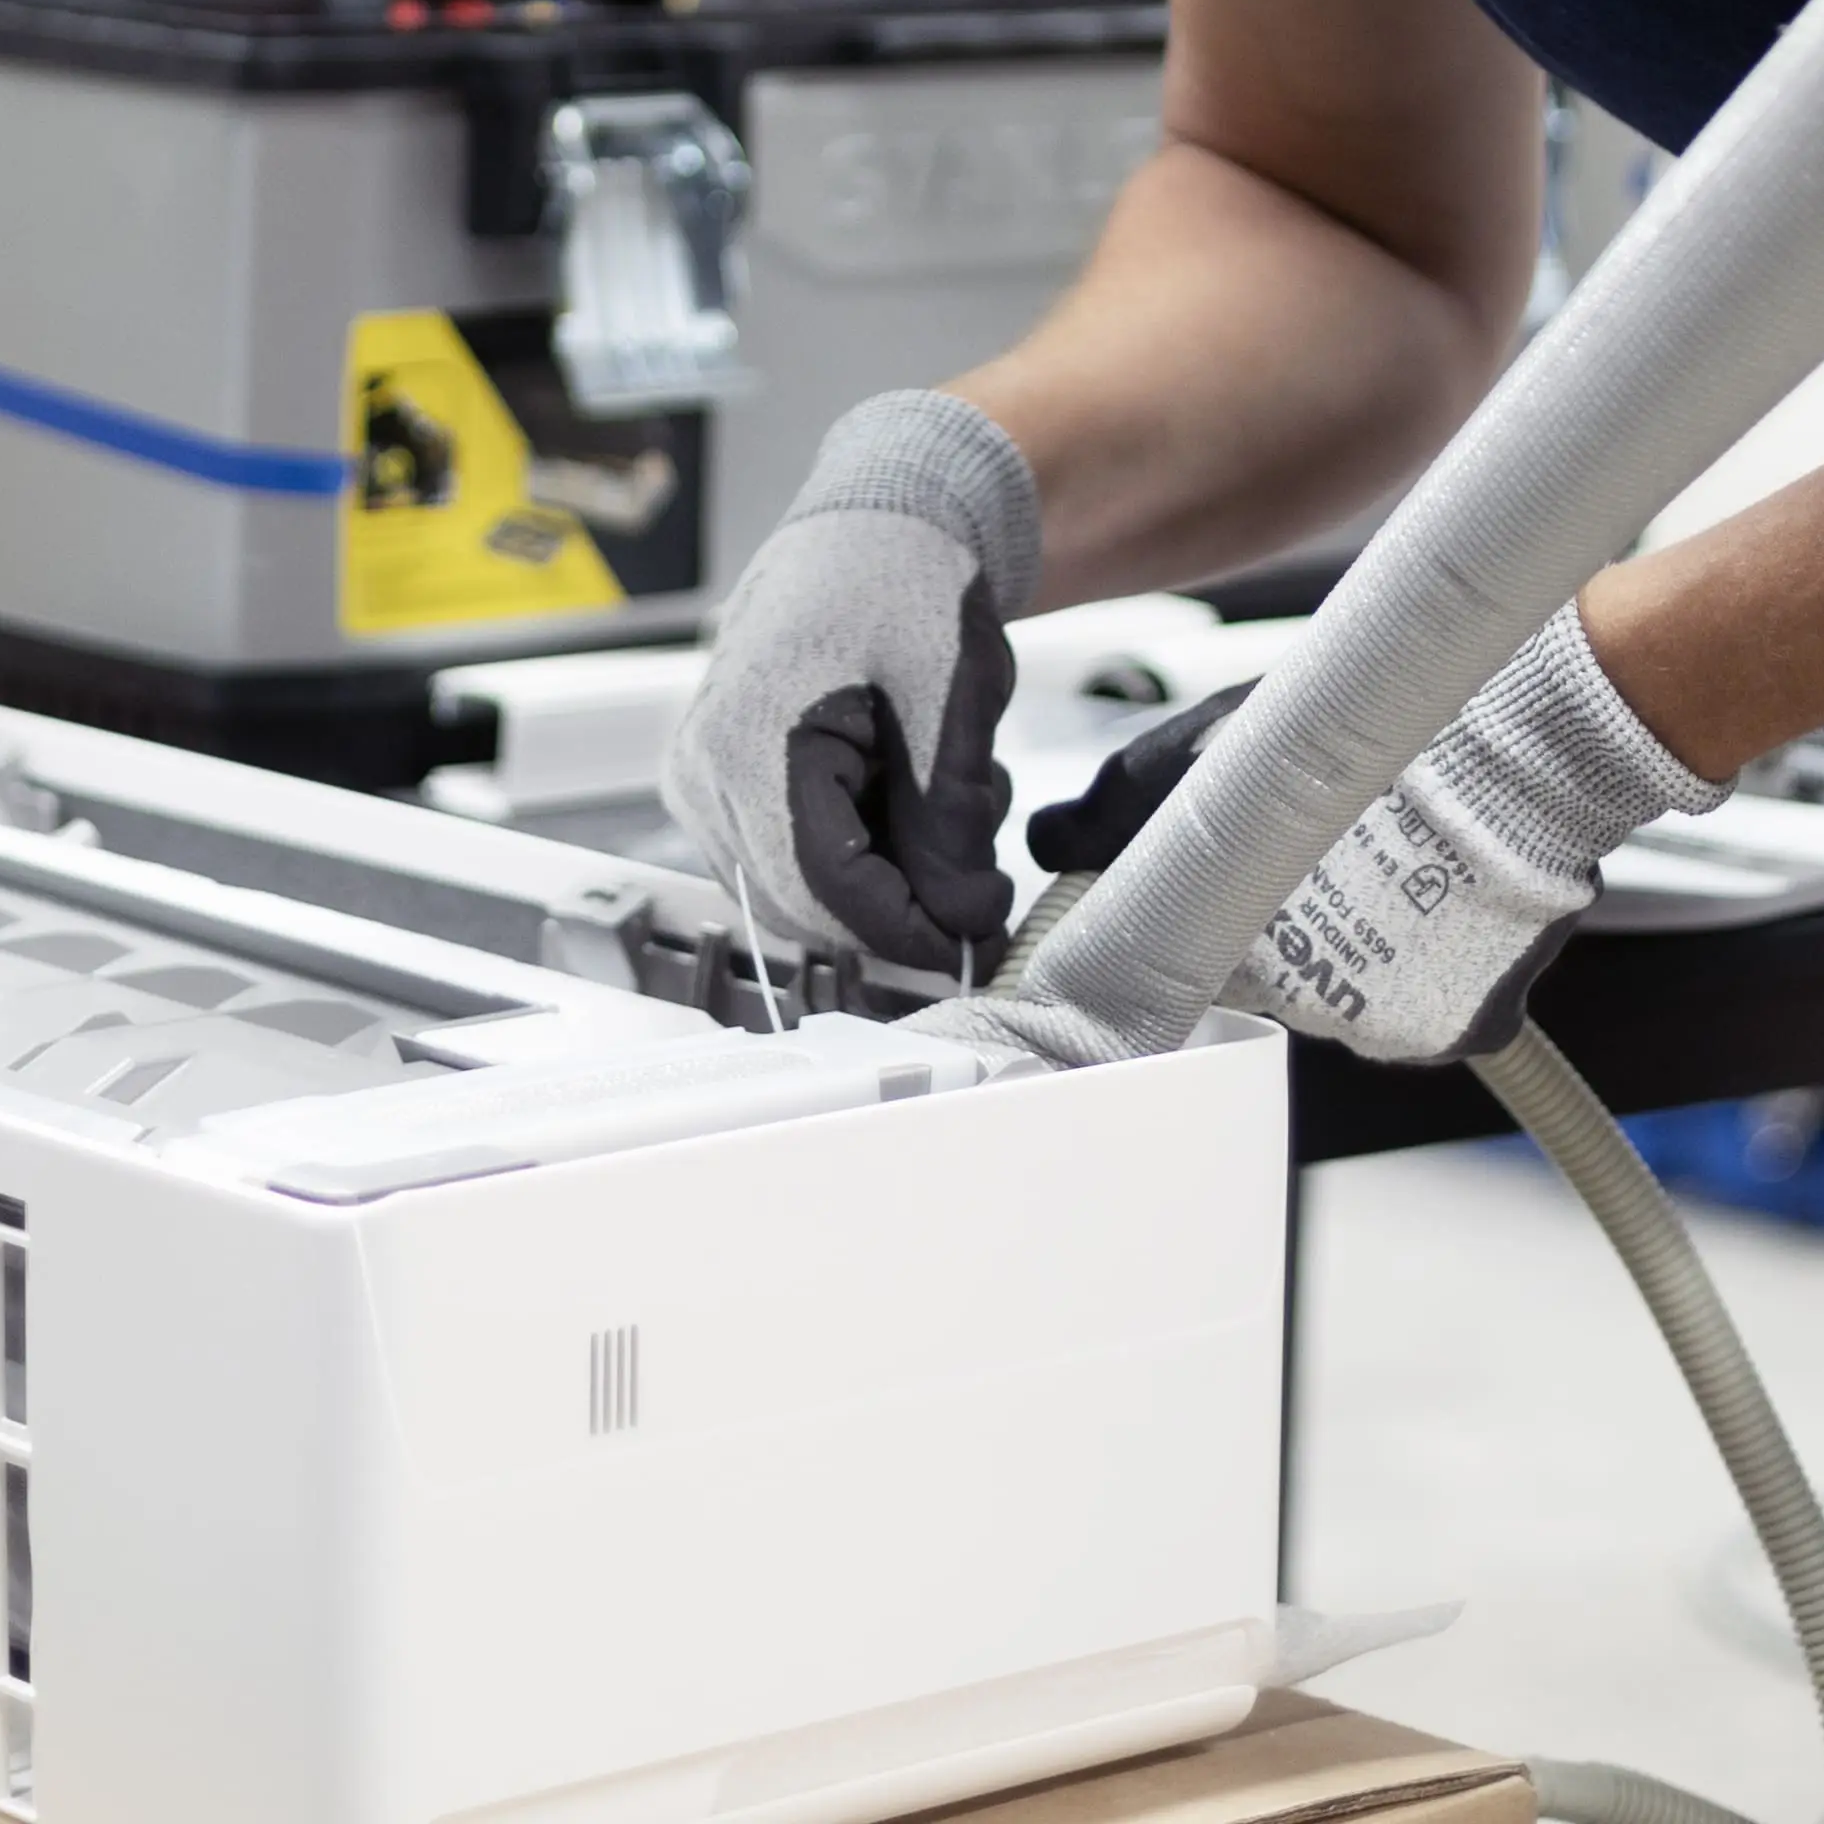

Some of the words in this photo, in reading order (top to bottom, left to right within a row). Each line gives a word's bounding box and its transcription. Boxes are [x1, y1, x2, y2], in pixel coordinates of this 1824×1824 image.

[1374, 849, 1399, 877] EN
[1300, 896, 1368, 974] UNIDUR
[1353, 917, 1396, 964] 6659
